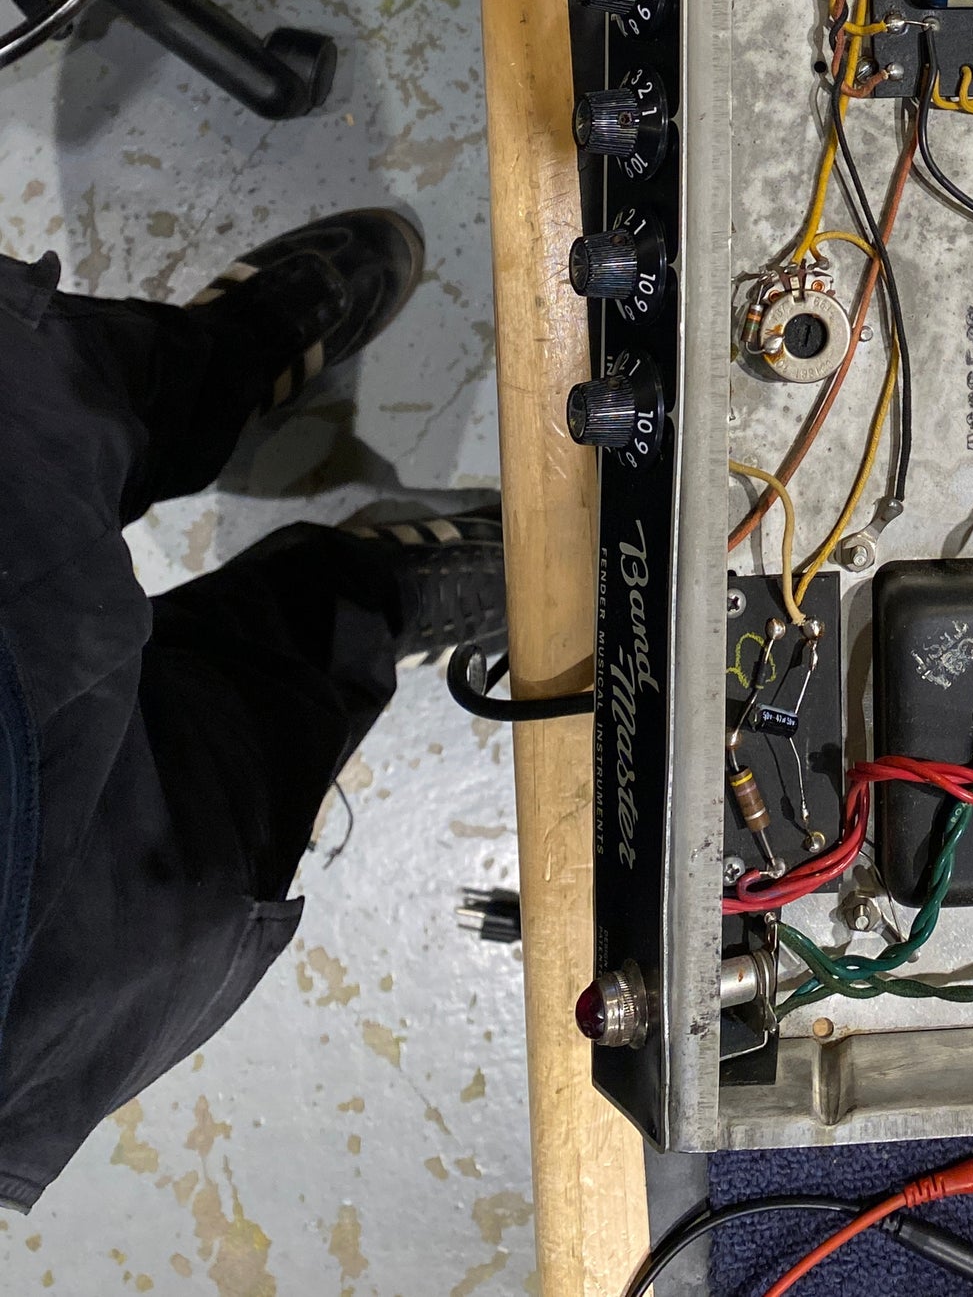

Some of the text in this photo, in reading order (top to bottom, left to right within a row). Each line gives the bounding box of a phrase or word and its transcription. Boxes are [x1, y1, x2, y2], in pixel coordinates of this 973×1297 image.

[637, 4, 651, 20] 9
[628, 18, 640, 36] 8
[638, 81, 653, 99] 2
[642, 106, 657, 117] 1
[630, 153, 648, 175] 10
[632, 218, 647, 235] 1
[638, 273, 656, 296] 10
[633, 300, 648, 313] 9
[638, 410, 654, 433] 10
[634, 440, 648, 455] 9
[618, 518, 660, 694] Band
[595, 547, 608, 856] FENDER MUSICAL INSTRUMENTS
